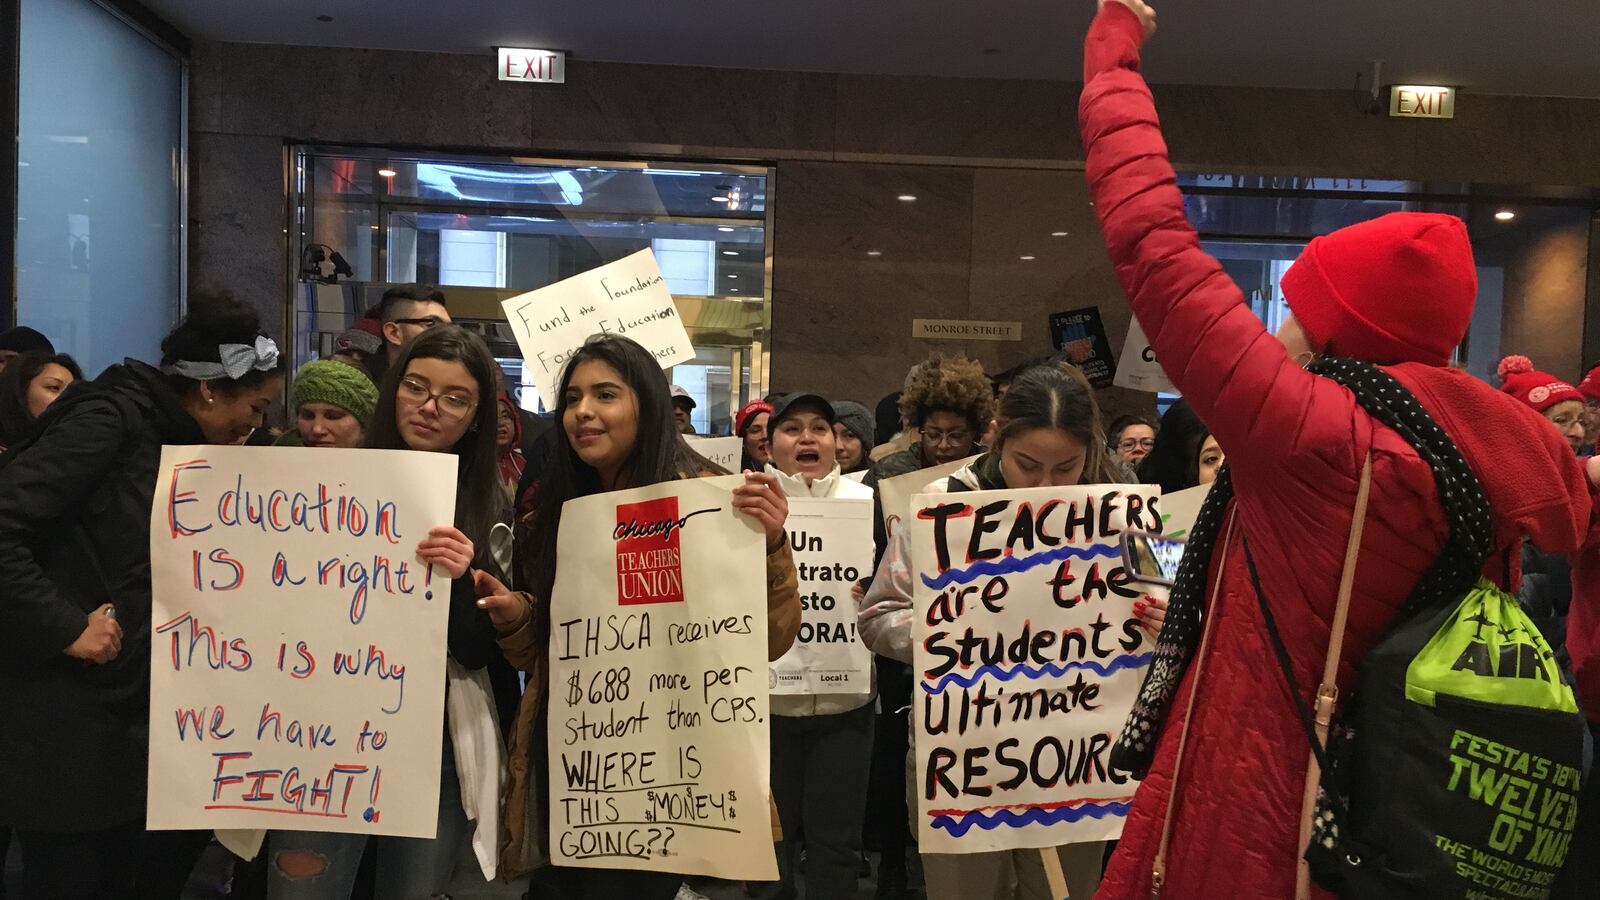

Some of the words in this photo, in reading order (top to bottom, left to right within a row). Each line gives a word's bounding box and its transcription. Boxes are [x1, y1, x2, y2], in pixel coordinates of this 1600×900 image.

[506, 54, 557, 80] EXIT
[1397, 90, 1448, 115] EXIT
[515, 301, 571, 338] Fund
[578, 304, 597, 317] the
[600, 274, 664, 300] Foundation
[598, 306, 675, 338] Education
[923, 324, 971, 334] MONROE
[972, 326, 1012, 336] STREET
[650, 345, 677, 360] hers
[168, 460, 402, 544] Education
[791, 531, 823, 552] Un
[917, 490, 1163, 574] TEACHERS
[617, 547, 680, 572] TEACHERS
[798, 562, 859, 582] trato
[272, 552, 307, 587] a
[318, 552, 434, 625] right!
[619, 567, 681, 600] UNION
[925, 575, 1010, 627] are
[1046, 560, 1144, 609] the
[800, 592, 836, 611] sto
[559, 612, 651, 661] IHSCA
[668, 615, 753, 646] receives
[797, 622, 856, 643] ORA!
[155, 610, 252, 672] This
[277, 632, 317, 679] is
[333, 644, 406, 714] why
[820, 674, 842, 682] Local
[1450, 640, 1552, 684] AIR
[564, 666, 631, 707] $688
[650, 673, 691, 692] more
[703, 666, 752, 704] per
[257, 703, 336, 751] have
[356, 720, 388, 753] to
[667, 699, 701, 730] than
[711, 697, 764, 724] CPS.
[561, 750, 656, 794] WHERE
[679, 745, 702, 779] IS
[1450, 729, 1552, 781] FESTA'S
[211, 752, 382, 823] FIGHT!
[1447, 754, 1570, 829] TWELVE
[560, 797, 620, 825] THIS
[560, 826, 676, 857] GOING??
[1435, 834, 1472, 860] THE
[1488, 813, 1533, 856] OF
